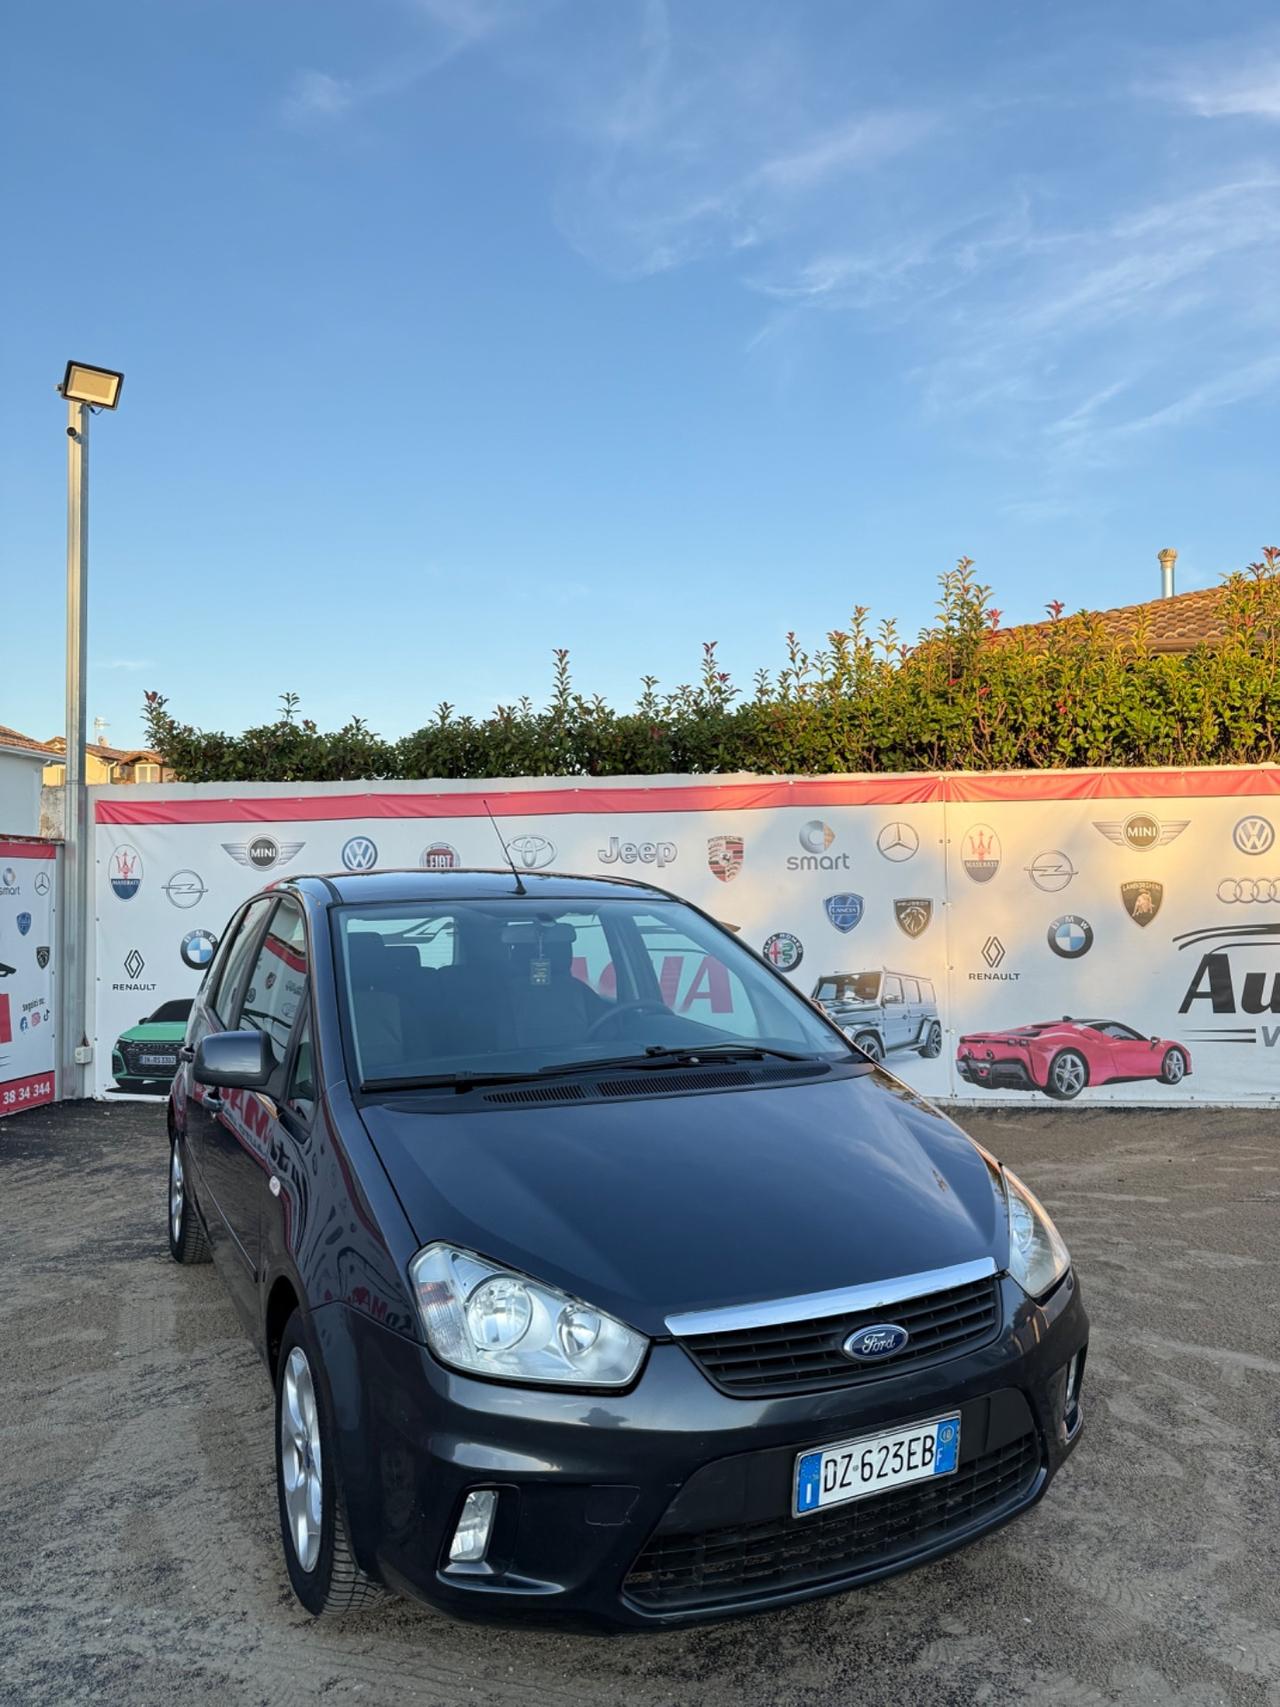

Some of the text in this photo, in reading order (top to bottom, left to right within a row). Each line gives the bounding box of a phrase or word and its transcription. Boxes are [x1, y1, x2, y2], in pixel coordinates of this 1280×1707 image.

[1126, 826, 1157, 837] MINI
[250, 848, 276, 857] MINI
[597, 837, 678, 867] Jeep
[786, 853, 851, 871] smart
[968, 972, 1021, 981] RENAULT
[111, 983, 157, 992] RENAULT
[3, 1081, 50, 1105] 38 34 344
[861, 1331, 896, 1354] Ford
